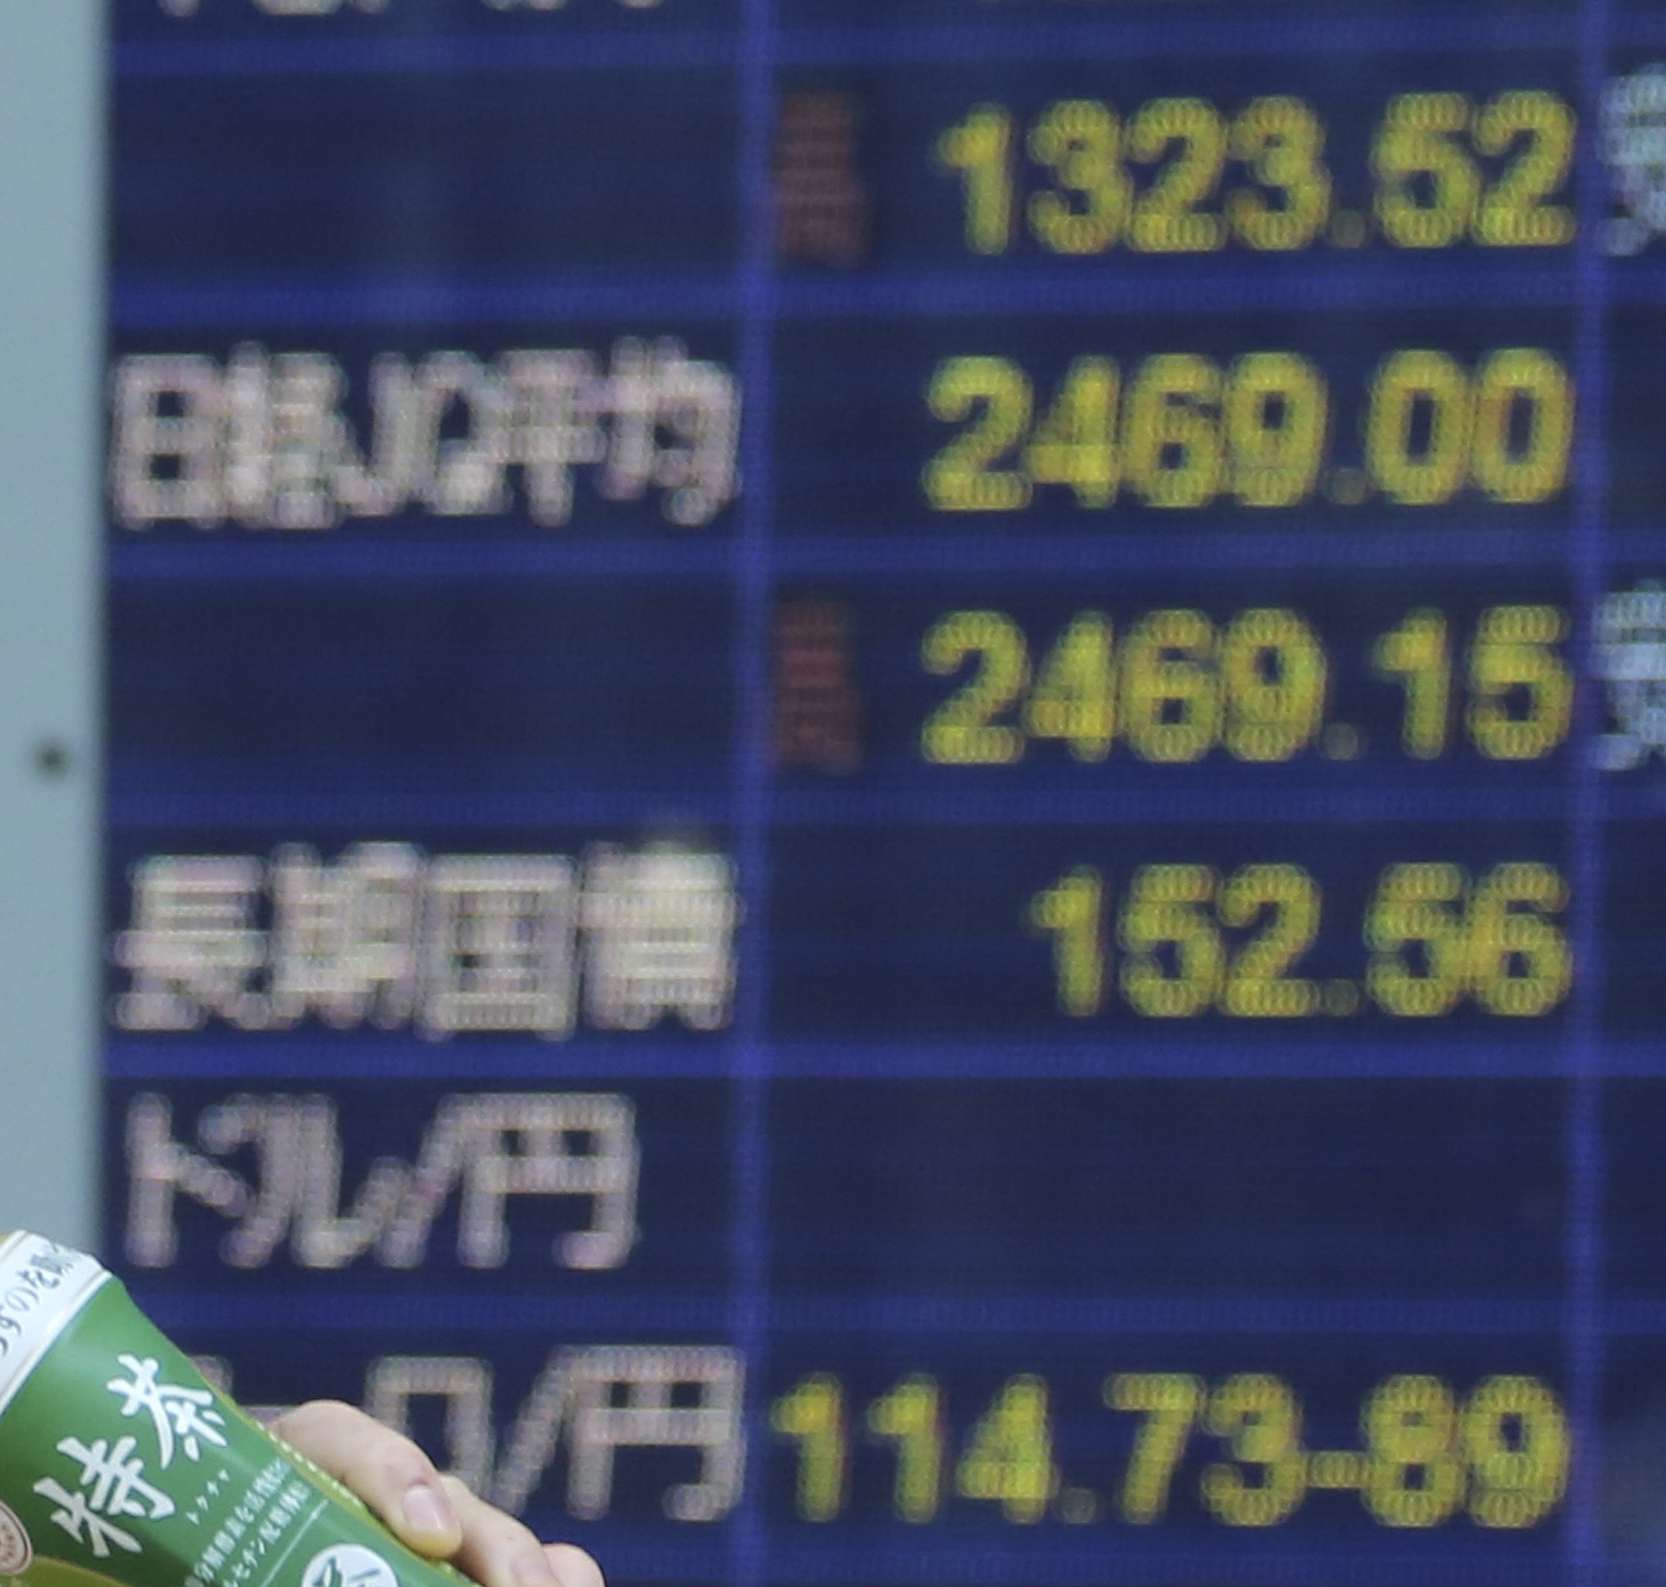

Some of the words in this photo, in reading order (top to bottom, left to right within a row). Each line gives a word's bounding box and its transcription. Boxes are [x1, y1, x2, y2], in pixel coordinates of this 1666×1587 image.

[940, 90, 1577, 254] 1323.52
[924, 348, 1575, 512] 2469.00
[922, 605, 1575, 763] 2469.15
[1031, 862, 1573, 1017] 152.56
[33, 1353, 228, 1558] 特茶
[363, 1345, 747, 1522] ロ/円
[772, 1374, 1571, 1528] 114.73-89
